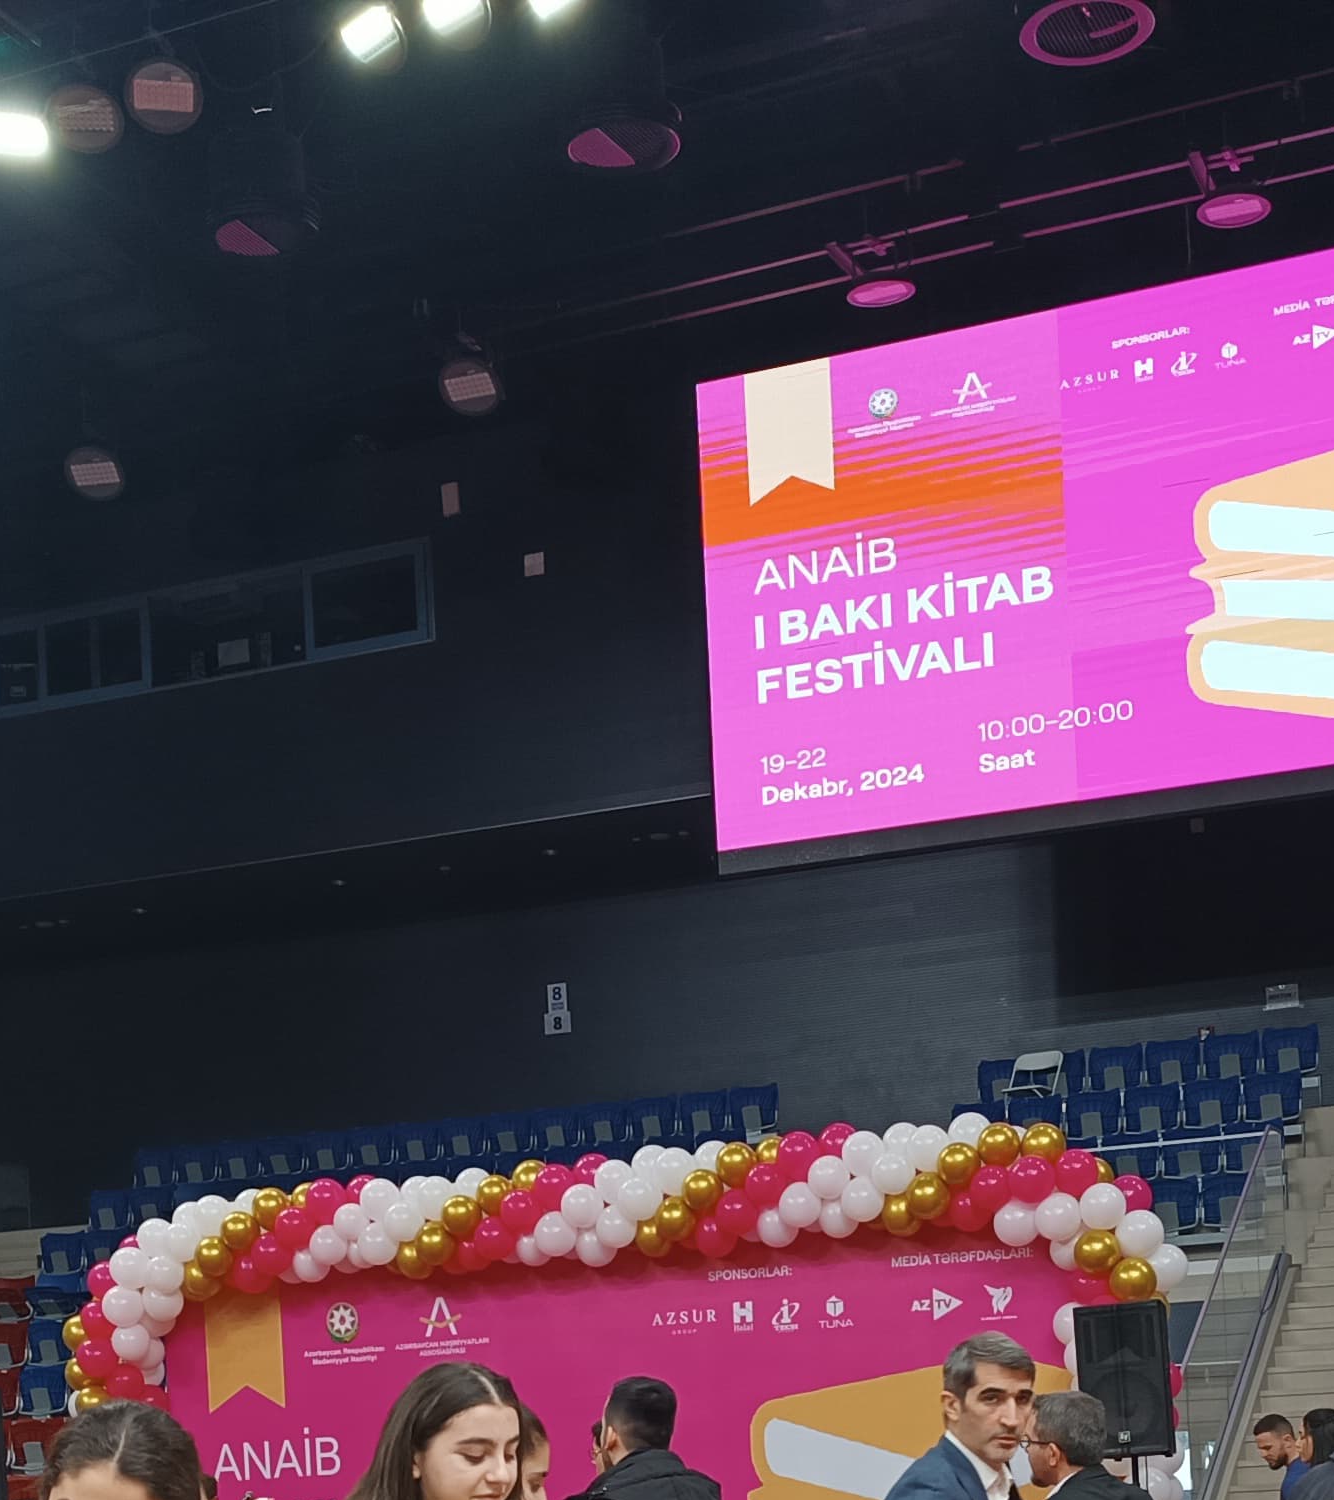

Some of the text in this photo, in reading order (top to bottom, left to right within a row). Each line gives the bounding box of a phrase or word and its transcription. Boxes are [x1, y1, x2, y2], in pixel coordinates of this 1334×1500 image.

[753, 533, 898, 596] ANAİB
[778, 592, 894, 648] BAKI
[907, 564, 1055, 627] KİTAB
[756, 631, 996, 705] FESTİVALI
[978, 748, 1036, 775] Saat
[760, 763, 925, 806] Dekabr, 2024
[552, 986, 562, 1001] 8
[553, 1016, 563, 1030] 8
[891, 1250, 932, 1268] MEDİA
[708, 1266, 793, 1283] SPONSORLAR:
[911, 1299, 932, 1312] AZ
[652, 1308, 718, 1328] AZSUR
[819, 1319, 855, 1330] TUNA
[214, 1427, 342, 1482] ANAİB
